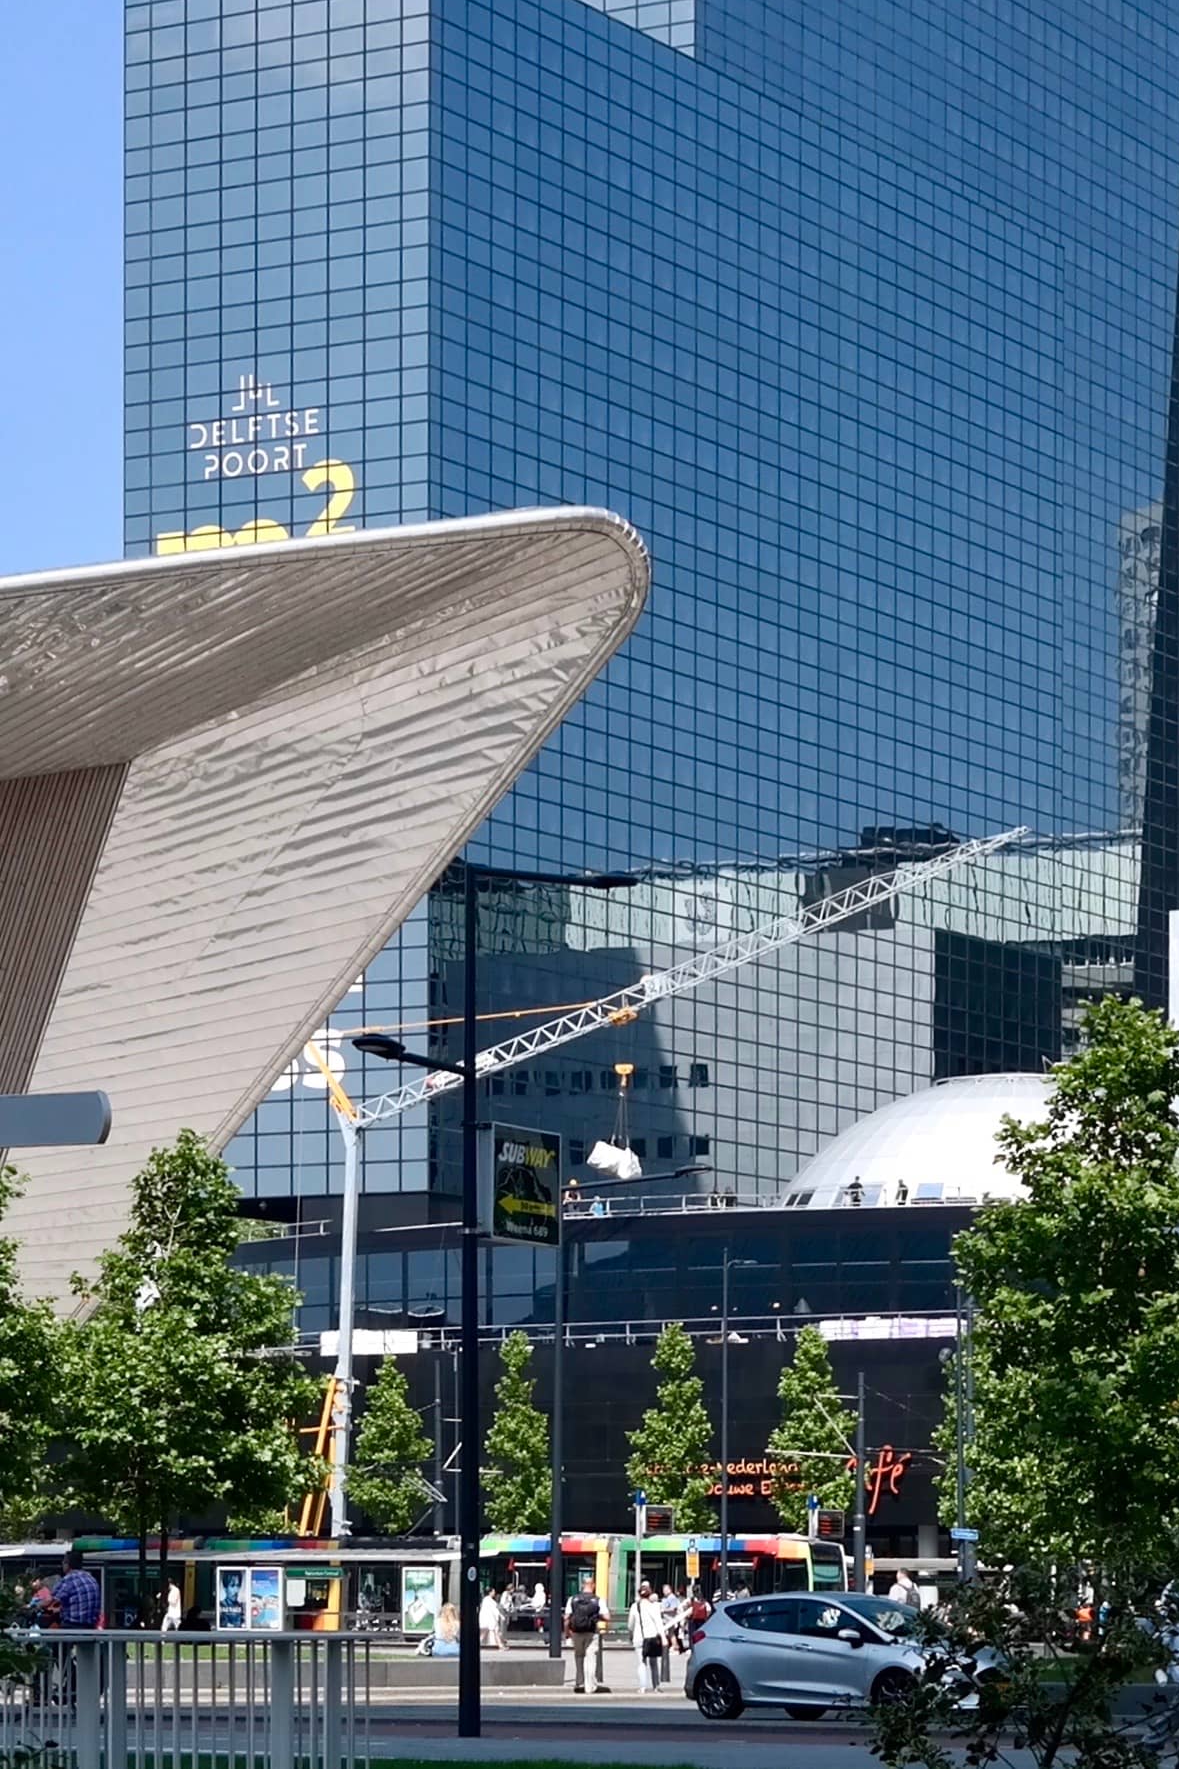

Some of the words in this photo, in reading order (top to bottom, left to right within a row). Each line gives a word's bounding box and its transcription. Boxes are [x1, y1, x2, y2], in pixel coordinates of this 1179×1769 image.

[190, 408, 320, 449] DELFTSE
[204, 443, 308, 480] POORT
[498, 1141, 556, 1168] SUBWAY
